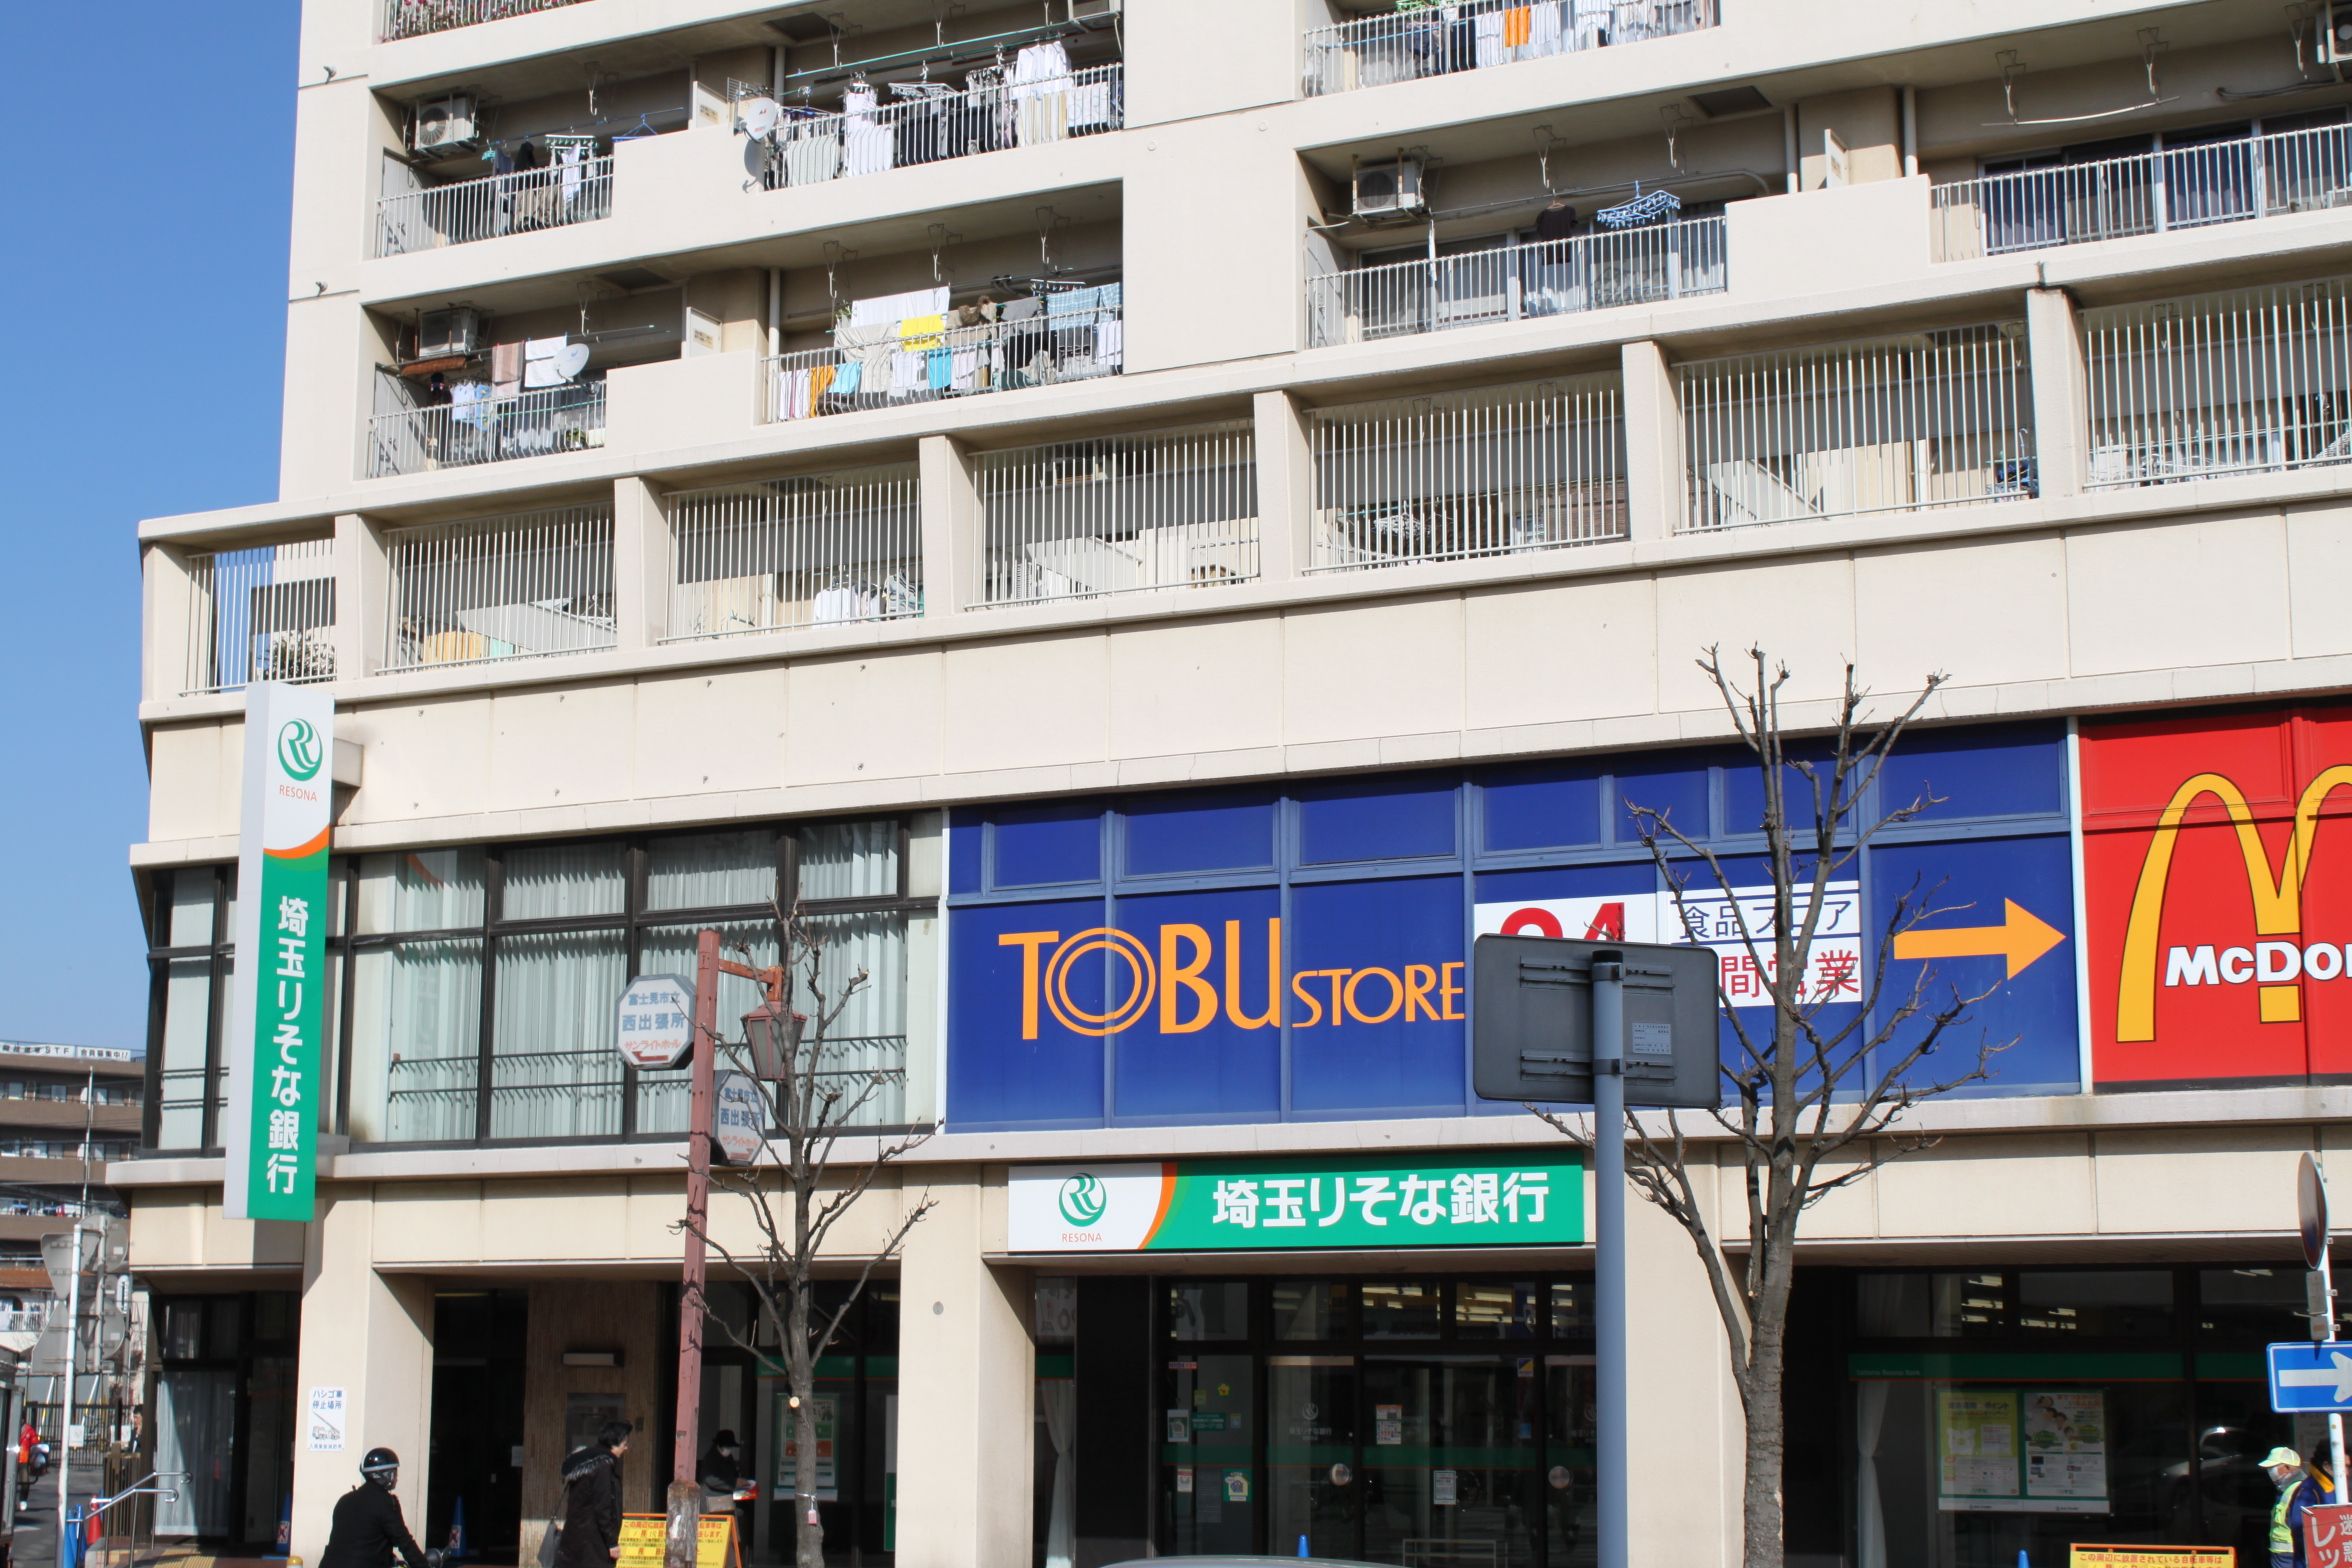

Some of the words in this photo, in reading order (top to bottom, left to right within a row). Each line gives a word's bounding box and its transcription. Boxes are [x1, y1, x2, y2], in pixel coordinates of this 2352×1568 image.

[278, 785, 318, 803] RESONA
[998, 918, 1281, 1040] TOBU
[1291, 961, 1465, 1027] STORE
[628, 990, 681, 1006] 富士見市立
[622, 1012, 684, 1031] 西出張所
[266, 895, 309, 1195] 埼玉りそな銀行
[1212, 1171, 1549, 1229] 埼玉りそな銀行
[1061, 1232, 1103, 1242] RESONA
